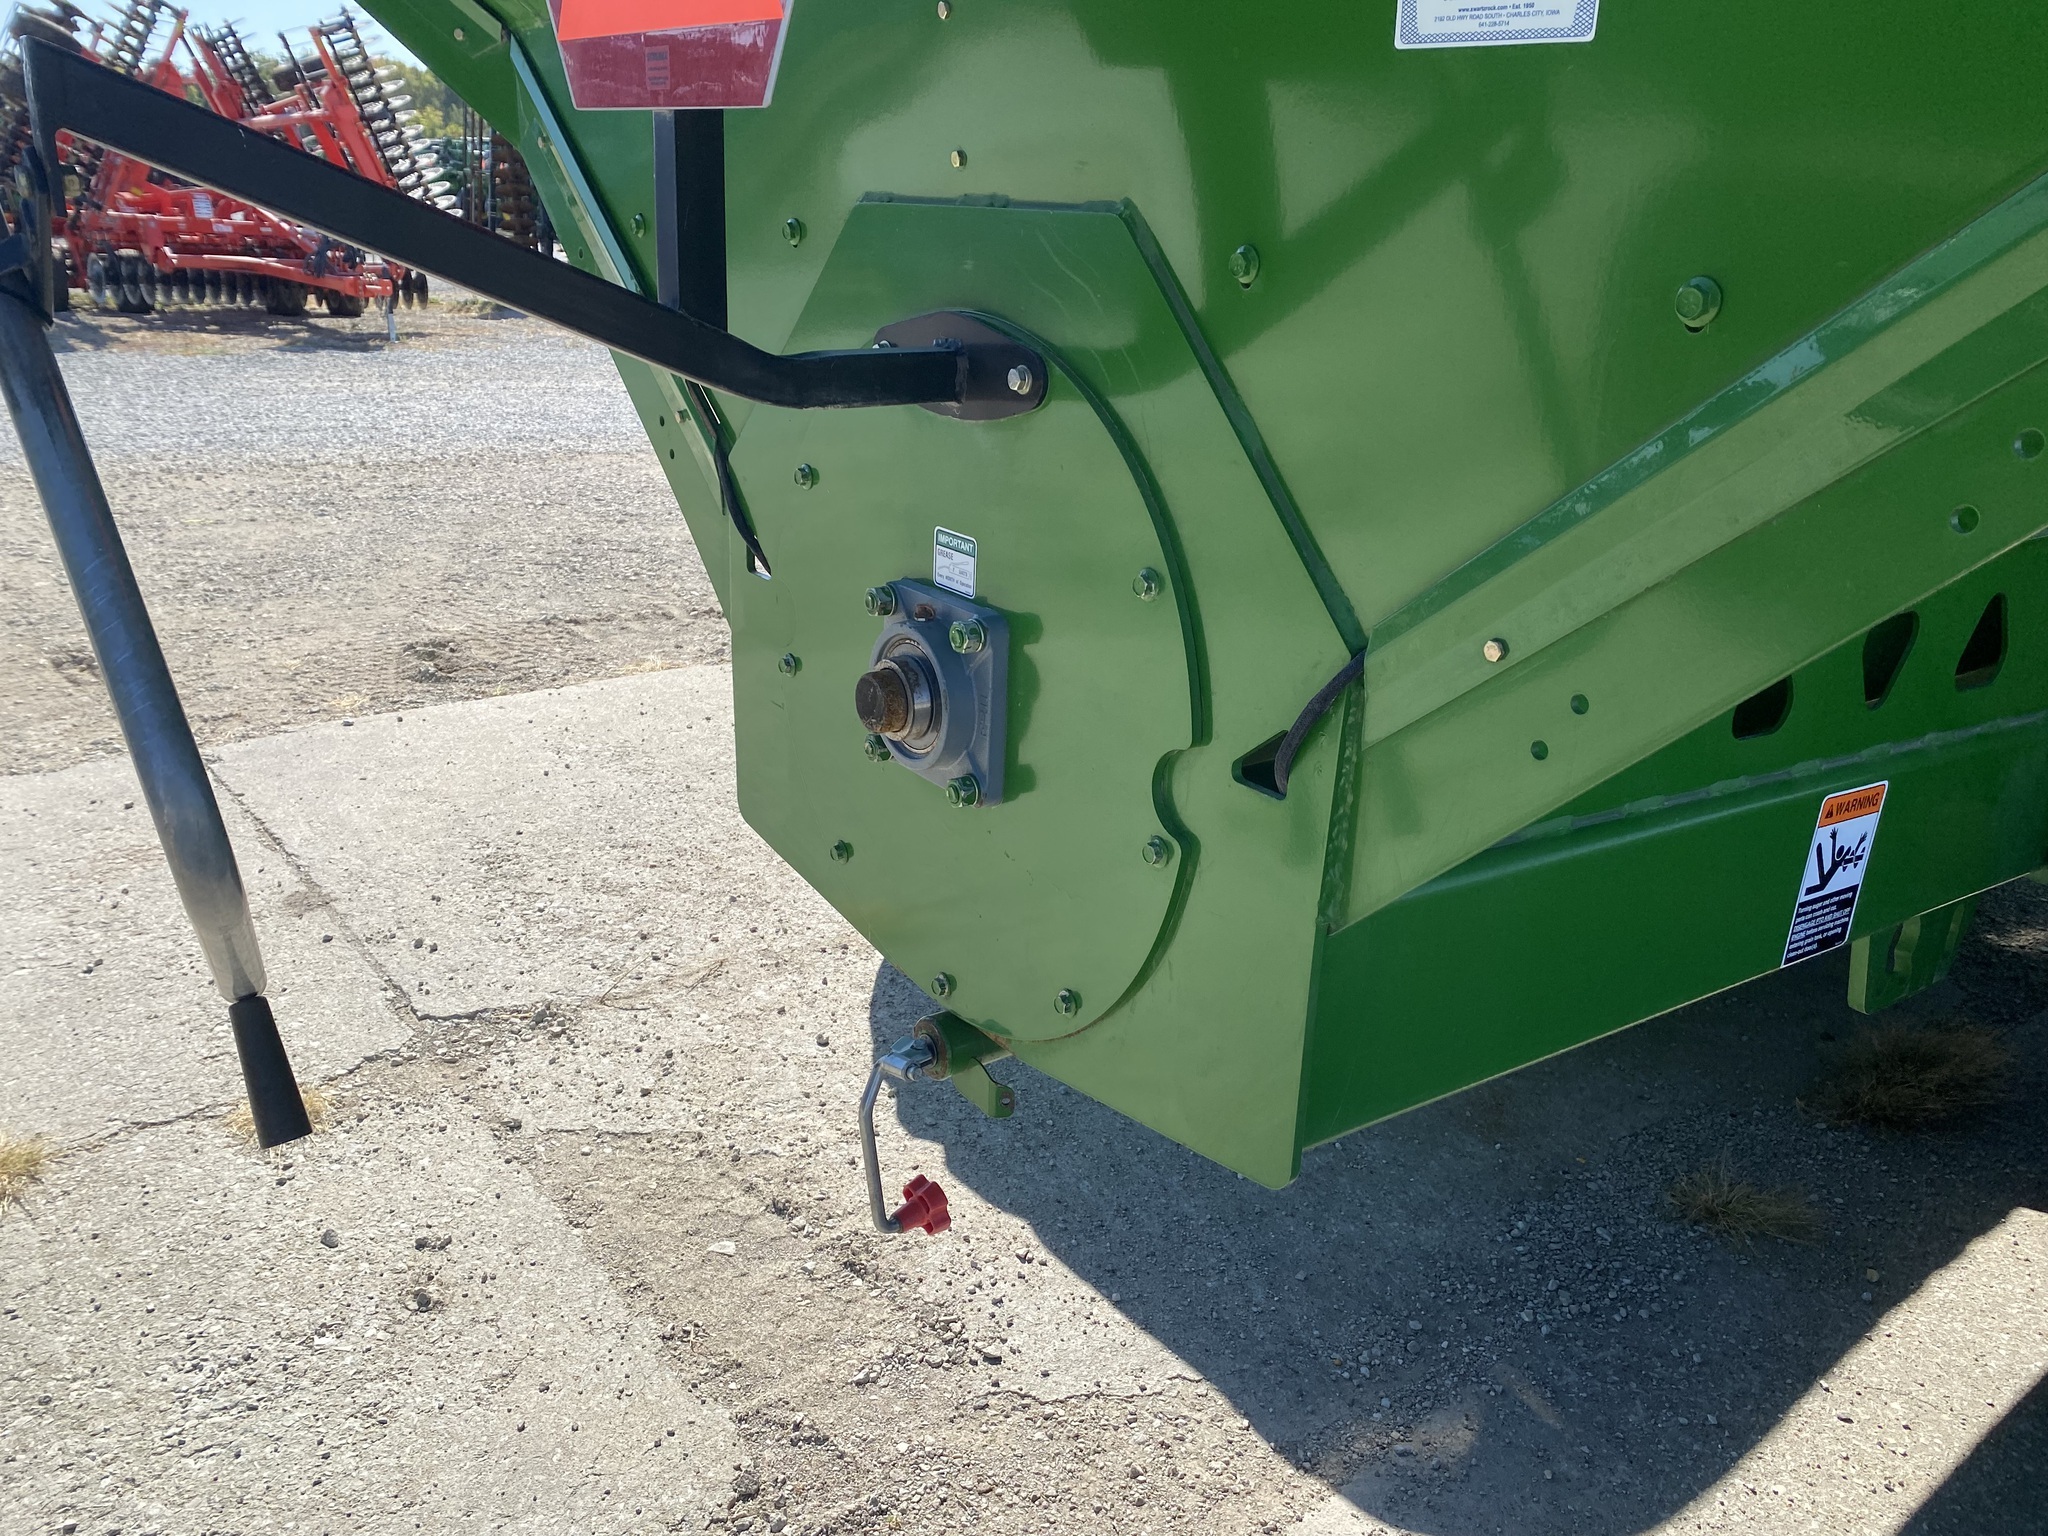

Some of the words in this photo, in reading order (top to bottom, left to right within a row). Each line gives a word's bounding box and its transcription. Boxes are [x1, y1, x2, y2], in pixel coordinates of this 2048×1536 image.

[938, 533, 974, 553] IMPORTANT
[938, 548, 954, 561] GREASE
[1836, 792, 1880, 816] WARNING
